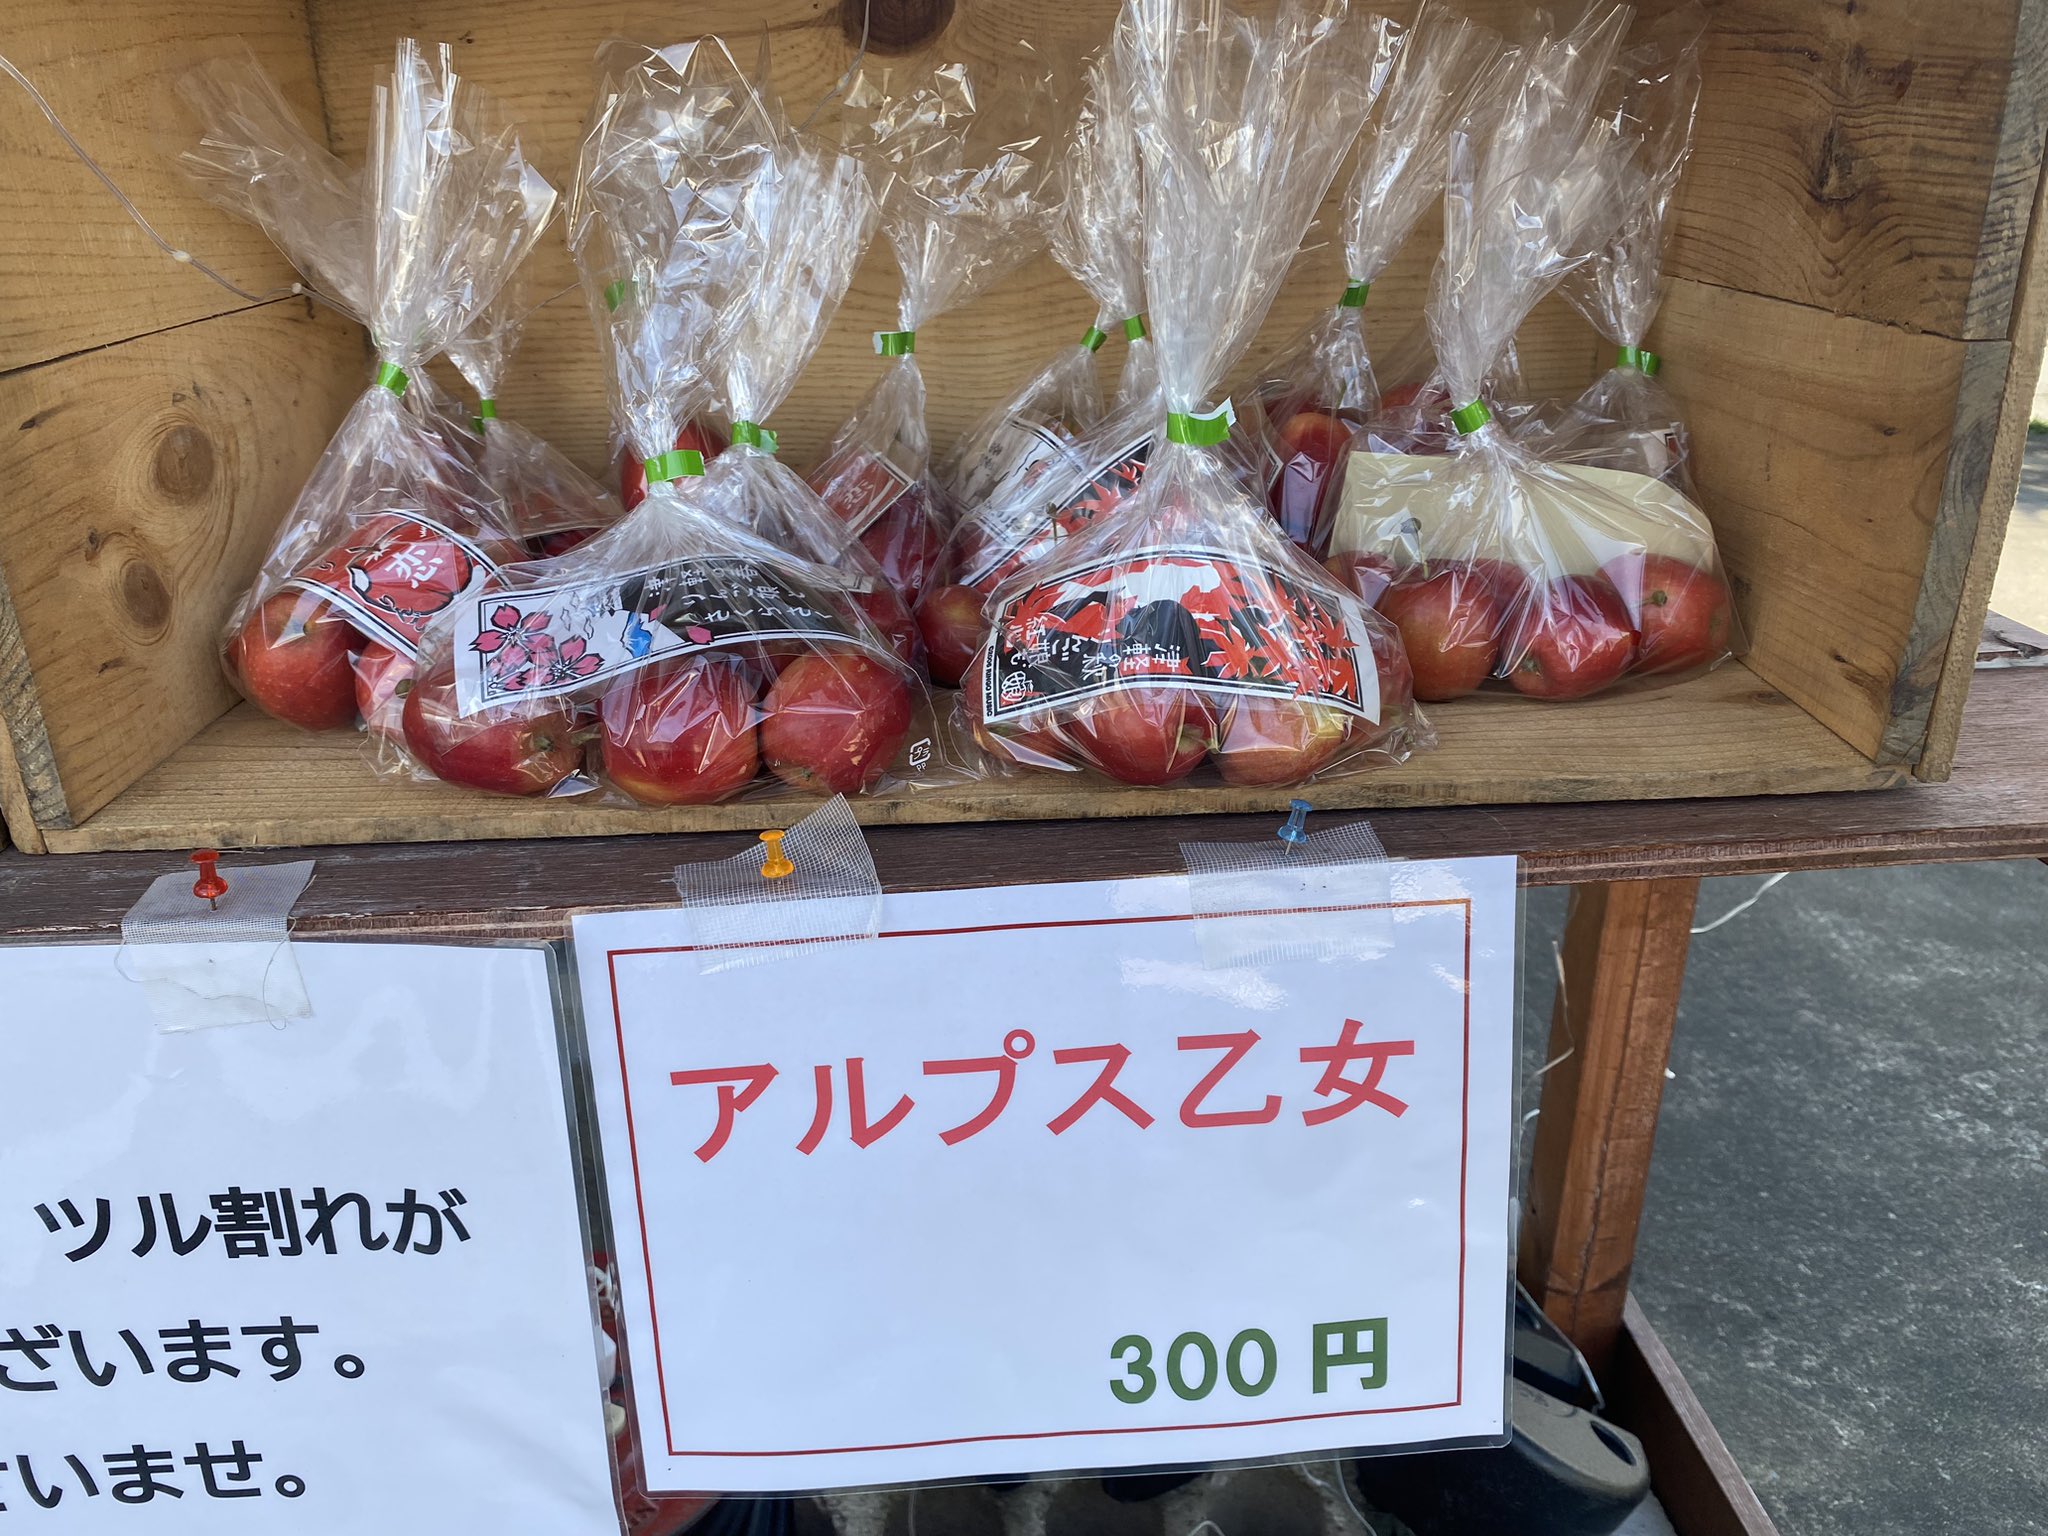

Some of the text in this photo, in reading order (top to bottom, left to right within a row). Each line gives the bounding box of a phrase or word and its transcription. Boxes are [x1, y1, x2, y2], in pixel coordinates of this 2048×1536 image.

[385, 544, 443, 589] 恋
[669, 1018, 1416, 1164] アルプス乙女
[33, 1185, 472, 1263] ツル割れが
[1109, 1317, 1389, 1403] 300 円
[0, 1440, 307, 1512] いませ。
